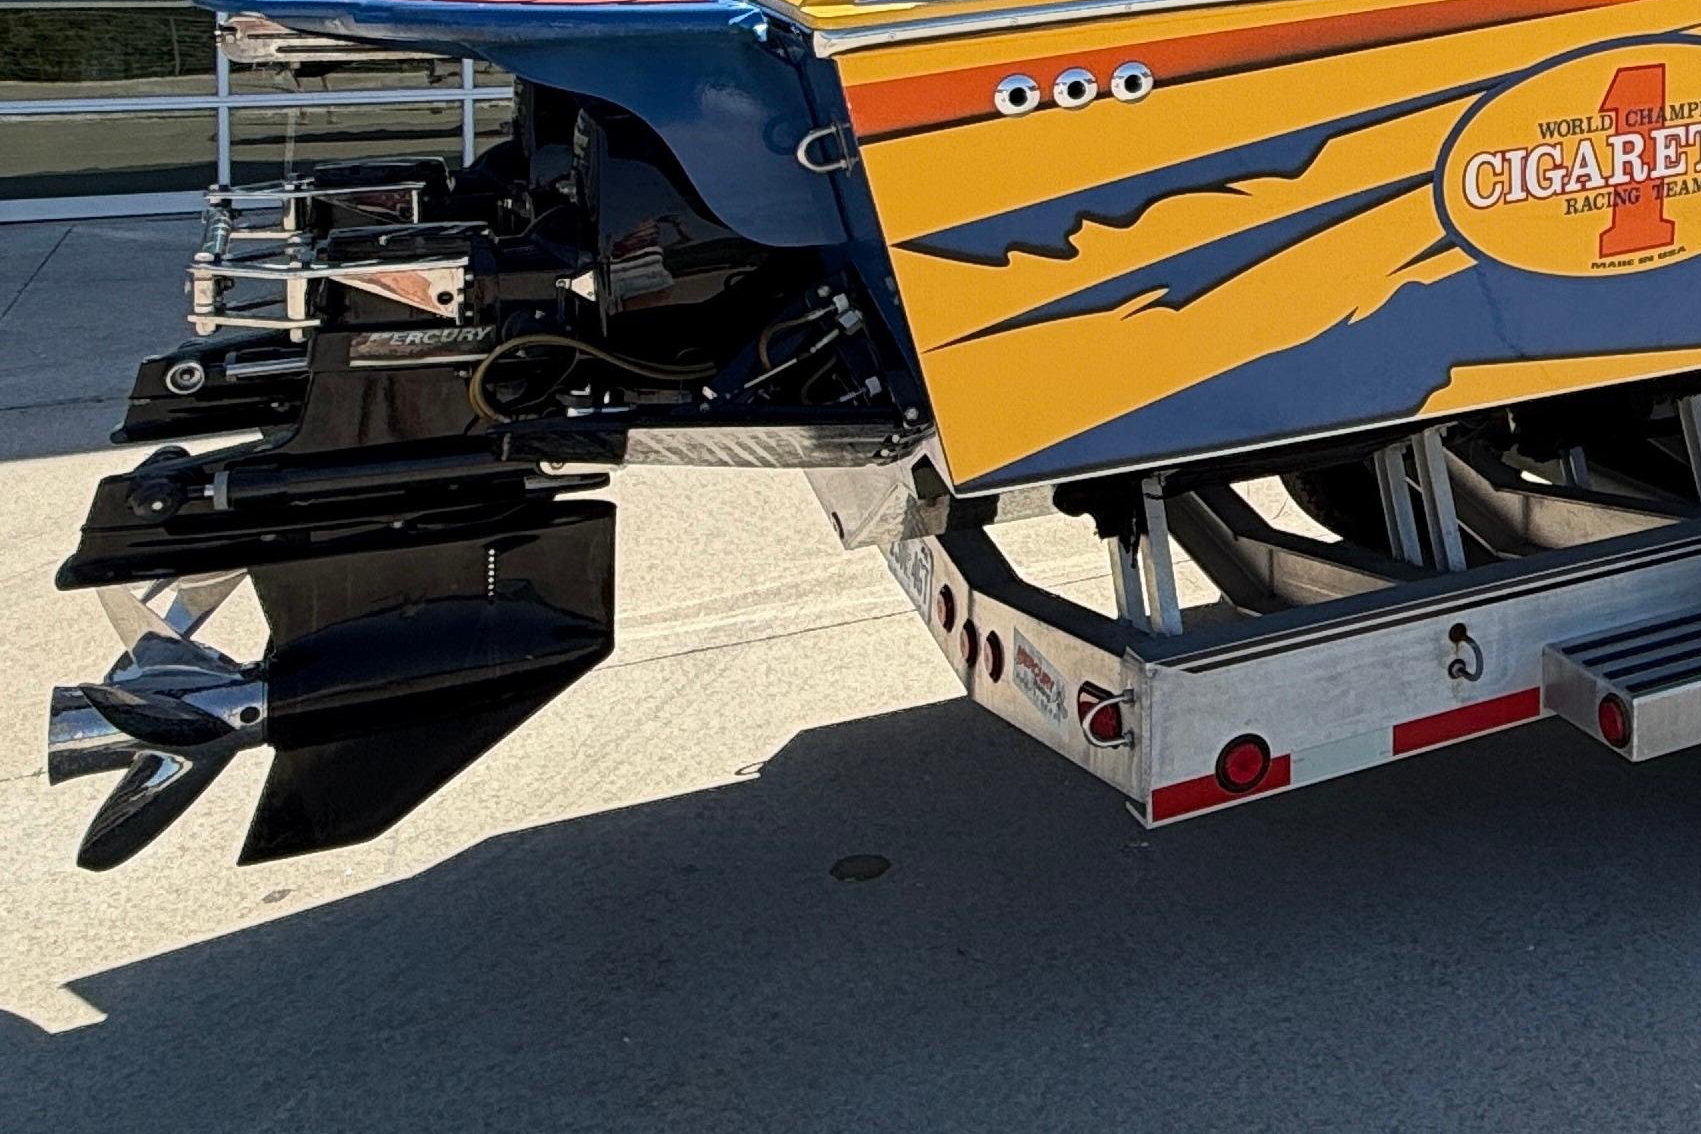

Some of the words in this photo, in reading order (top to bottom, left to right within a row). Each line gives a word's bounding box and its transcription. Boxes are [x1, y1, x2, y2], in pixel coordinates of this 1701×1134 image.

[1538, 113, 1615, 140] WORLD
[1563, 185, 1641, 216] RACING
[1591, 258, 1635, 269] MADE
[1638, 254, 1654, 264] IN
[1657, 245, 1687, 259] USA
